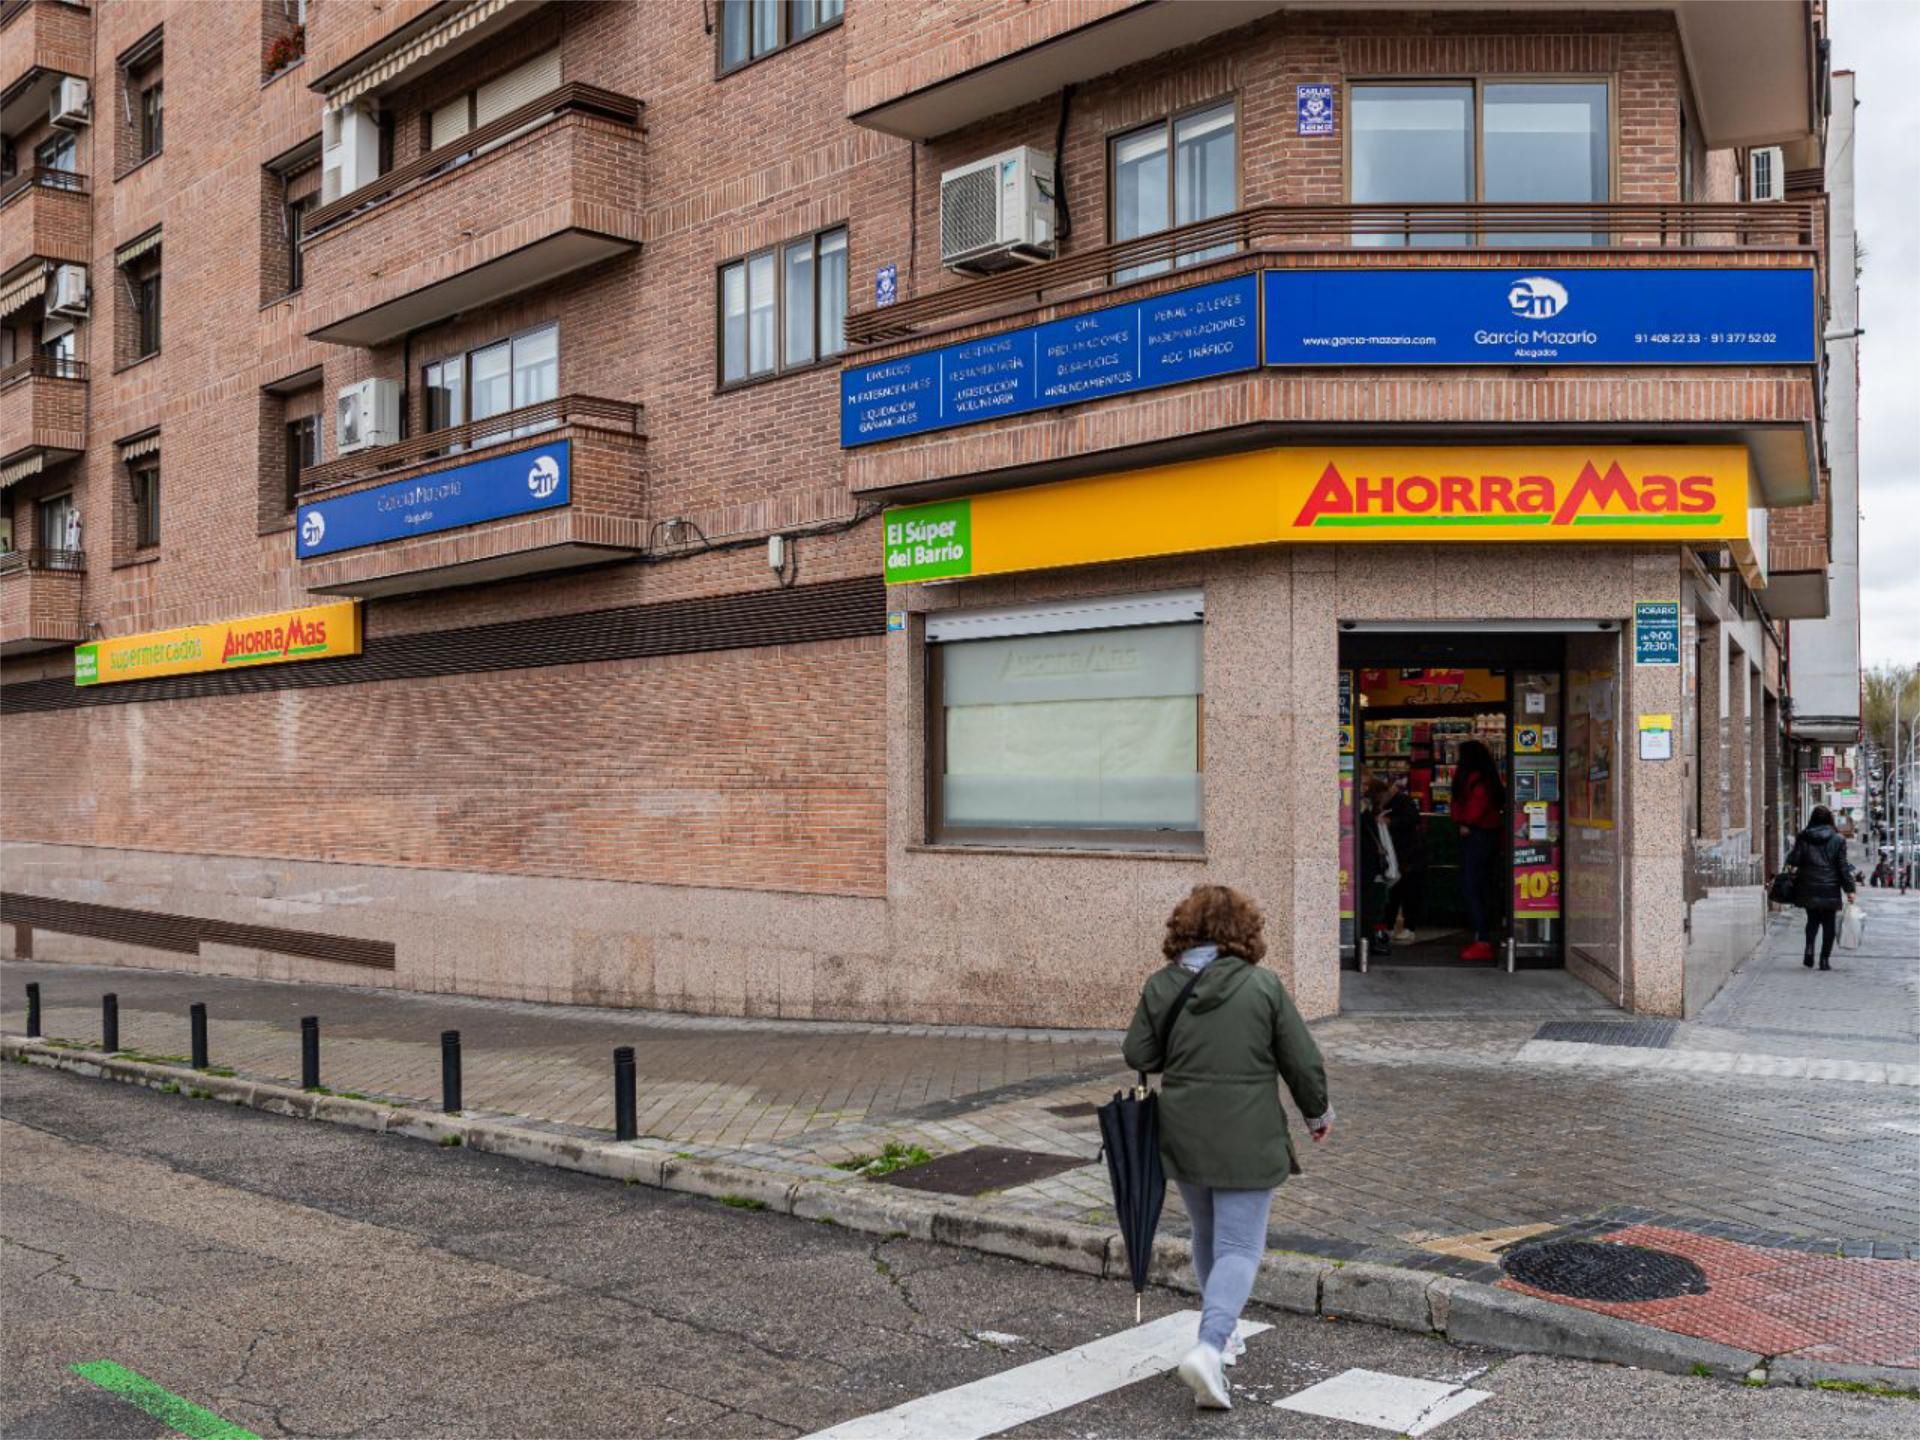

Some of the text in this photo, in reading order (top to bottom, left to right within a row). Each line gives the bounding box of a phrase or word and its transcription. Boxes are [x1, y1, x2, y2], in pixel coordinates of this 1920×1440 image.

[1634, 333, 1648, 343] 91
[1672, 333, 1685, 343] 22
[1687, 333, 1700, 343] 33
[1711, 333, 1724, 343] 91
[1726, 333, 1746, 343] 377
[888, 519, 957, 546] El Súper
[888, 541, 964, 568] del Barrio
[1637, 607, 1676, 615] HORARIO
